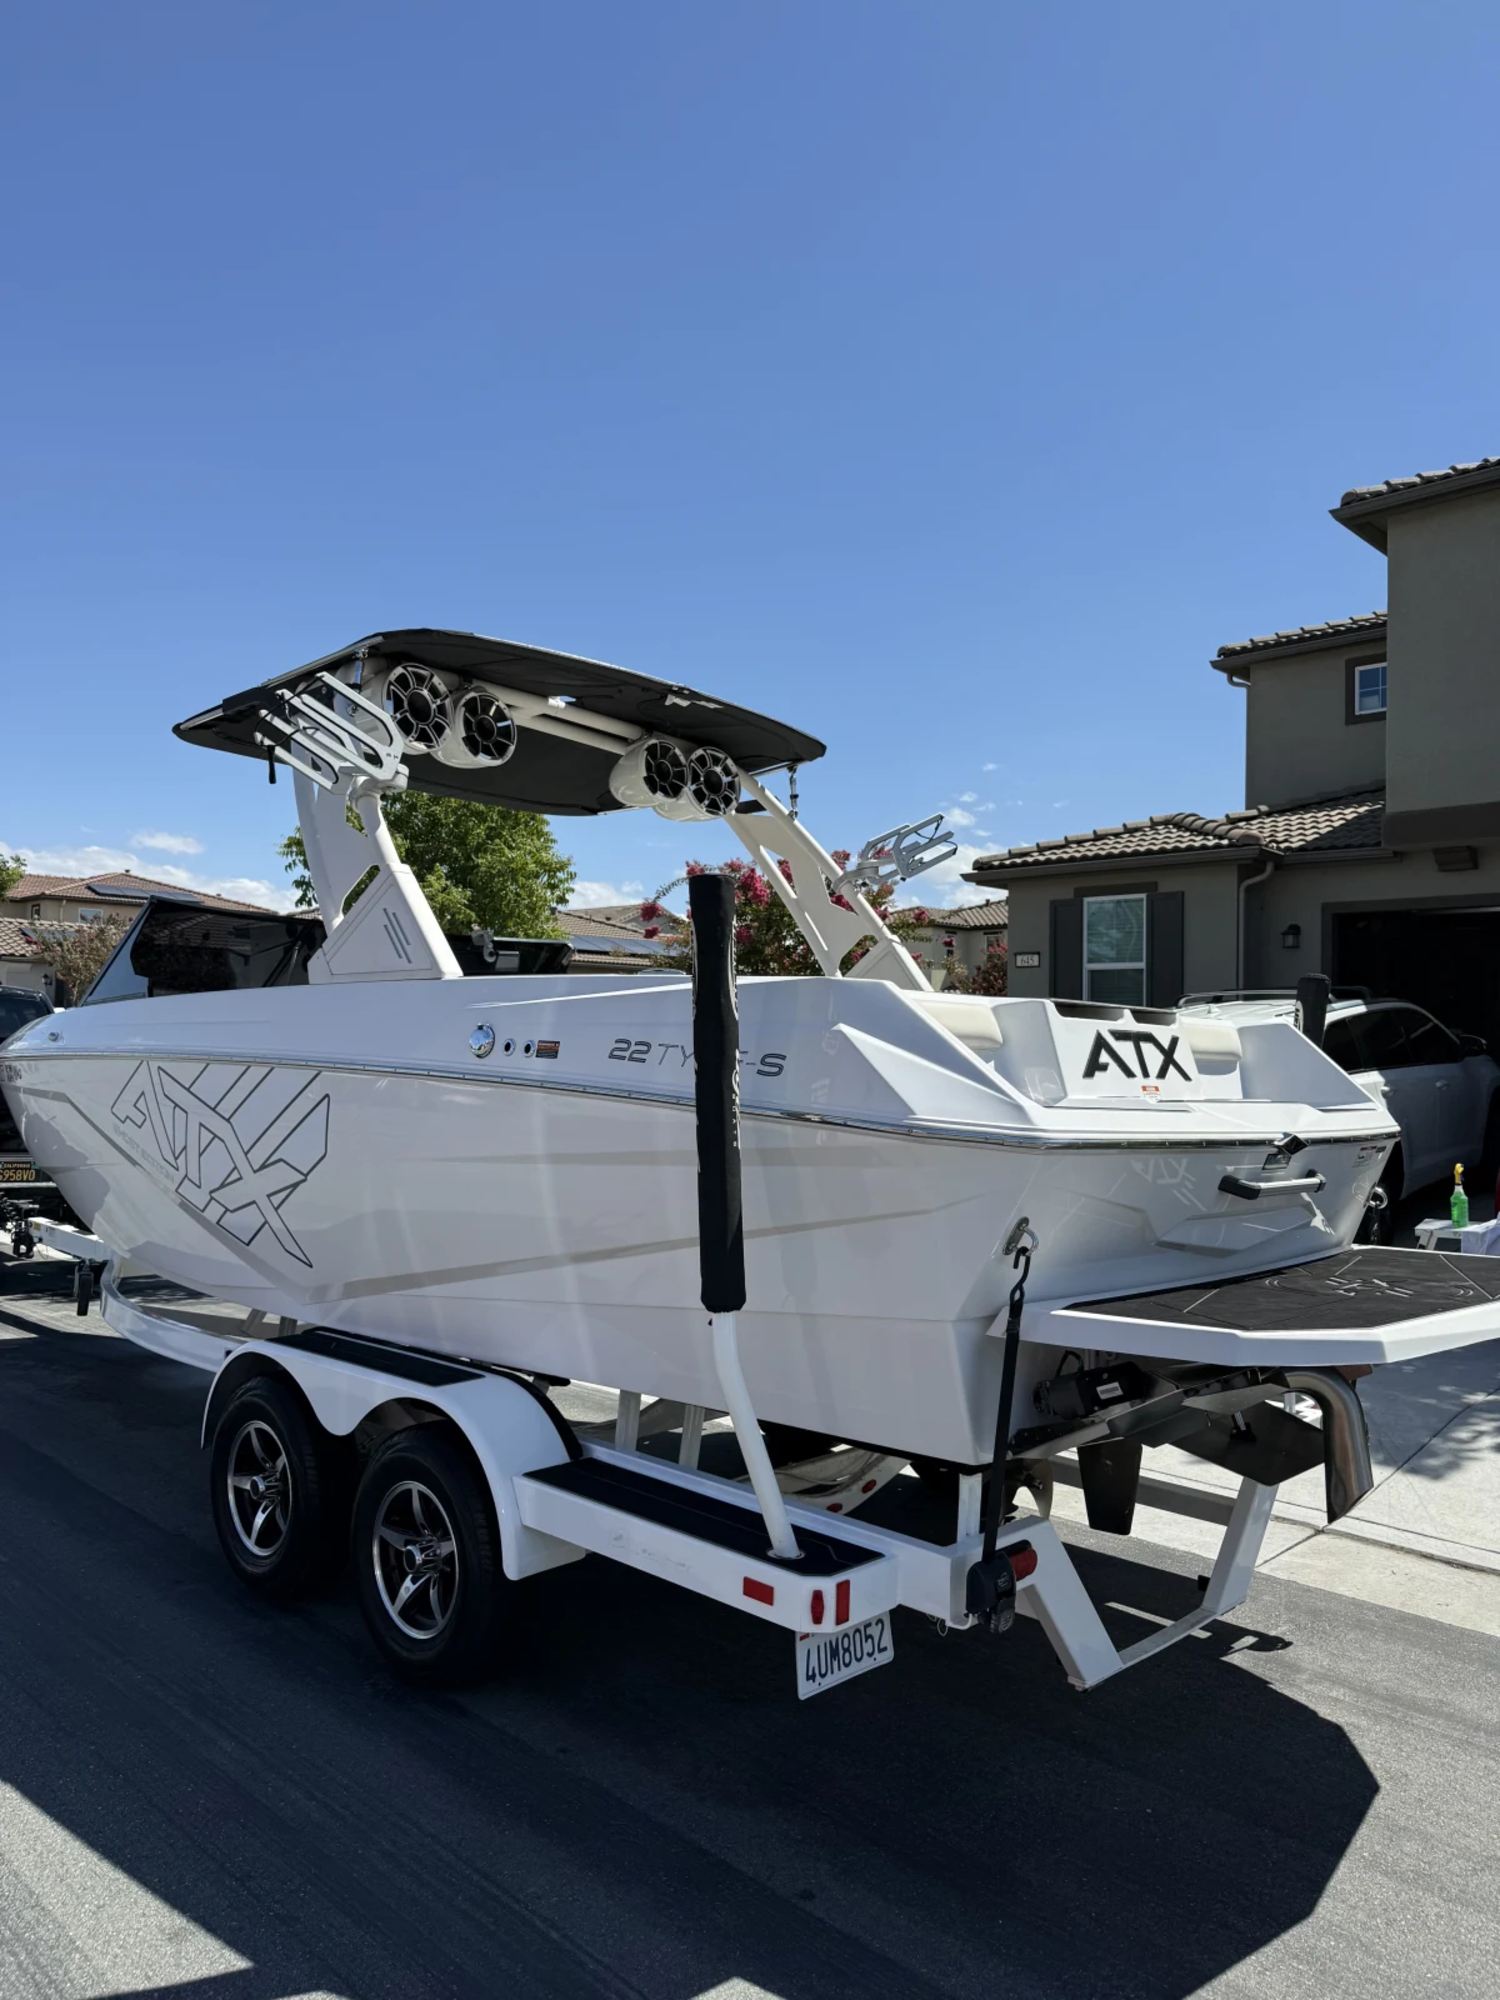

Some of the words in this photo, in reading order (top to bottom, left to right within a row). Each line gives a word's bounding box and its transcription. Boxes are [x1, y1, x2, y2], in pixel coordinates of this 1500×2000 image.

[1082, 1029, 1192, 1081] ATX
[111, 1060, 313, 1268] ATX
[805, 1618, 888, 1683] 4UM8052
